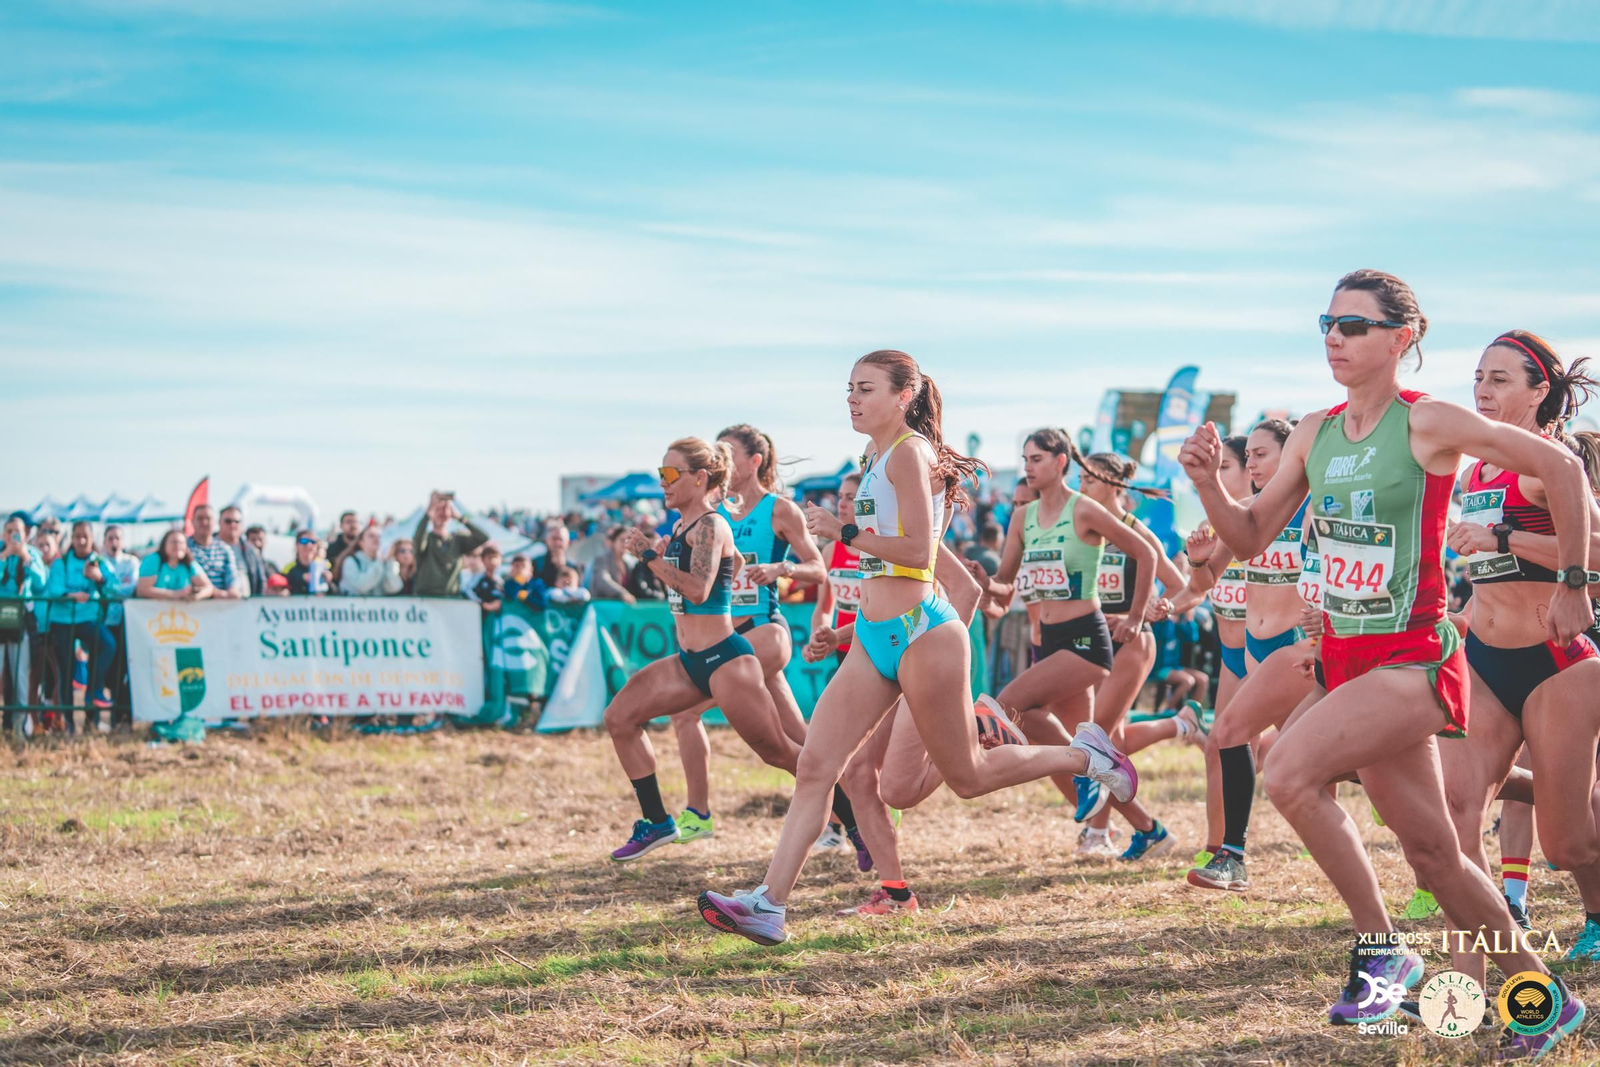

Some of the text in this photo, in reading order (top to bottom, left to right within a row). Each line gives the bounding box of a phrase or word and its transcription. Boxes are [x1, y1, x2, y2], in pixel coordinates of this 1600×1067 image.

[1248, 551, 1298, 570] 2241
[1016, 574, 1034, 592] 22
[1030, 566, 1066, 585] 2253
[1097, 572, 1120, 589] 49
[1323, 554, 1384, 593] 2244
[834, 583, 861, 600] 224
[1301, 582, 1322, 604] 22
[257, 605, 428, 628] Ayuntamiento de
[259, 630, 431, 666] Santiponce
[230, 691, 466, 711] EL DEPORTE A TU FAVOR
